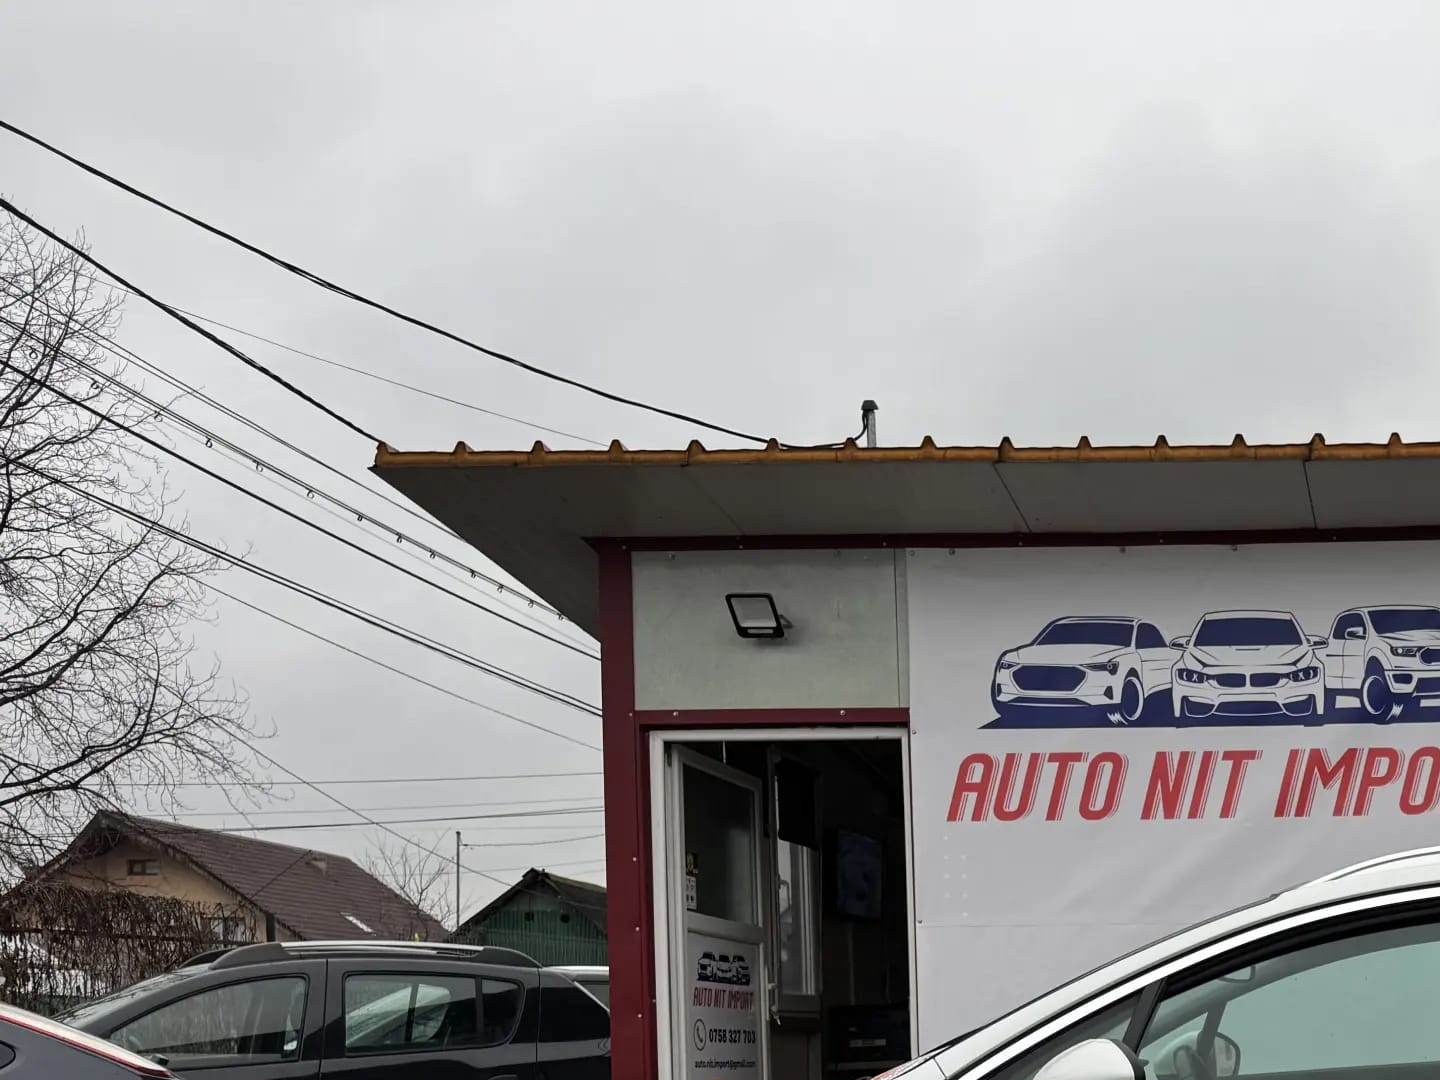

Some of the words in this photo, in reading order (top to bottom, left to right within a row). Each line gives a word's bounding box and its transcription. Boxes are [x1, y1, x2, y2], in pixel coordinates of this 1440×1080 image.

[946, 751, 1129, 822] AUTO
[1141, 749, 1263, 820] NIT
[693, 986, 713, 1007] AUTO
[714, 988, 726, 1008] NIT
[727, 991, 754, 1010] IMPORT
[709, 1029, 727, 1043] 0758
[728, 1030, 742, 1044] 327
[743, 1031, 756, 1044] 703
